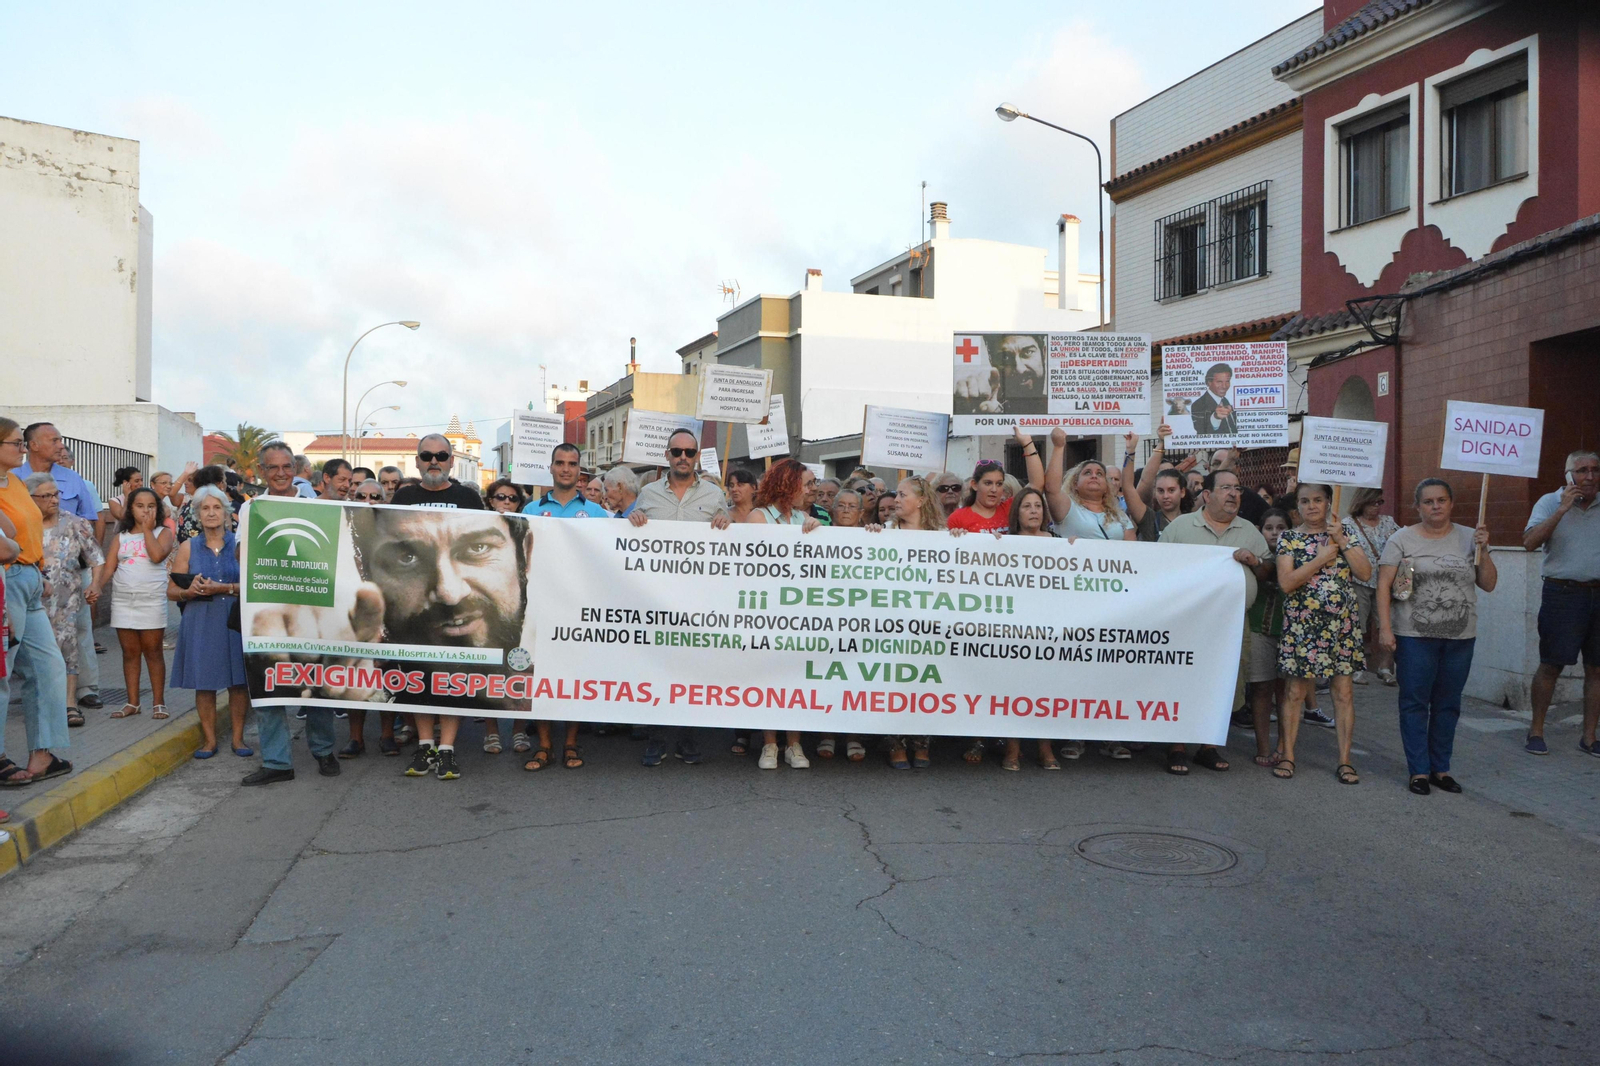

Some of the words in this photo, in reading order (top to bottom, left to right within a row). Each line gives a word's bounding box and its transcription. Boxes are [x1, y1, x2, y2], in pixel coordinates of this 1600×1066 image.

[1060, 359, 1128, 369] ¡¡¡DESPERTAD!!!
[1380, 376, 1386, 392] 6
[1075, 401, 1090, 410] LA
[1093, 401, 1120, 411] VIDA
[1240, 396, 1275, 406] ¡¡¡YA!!!
[975, 418, 994, 426] POR
[997, 418, 1017, 426] UNA
[1019, 418, 1060, 426] SANIDAD
[1062, 416, 1101, 426] PÚBLICA
[1103, 418, 1134, 426] DIGNA.
[1454, 417, 1531, 437] SANIDAD
[1341, 436, 1373, 444] ANDALUCIA
[887, 449, 909, 457] SUSANA
[1461, 439, 1519, 458] DIGNA
[520, 462, 545, 470] HOSPITAL
[1320, 468, 1347, 476] HOSPITAL
[615, 537, 706, 555] NOSOTROS
[709, 541, 741, 556] TAN
[745, 540, 789, 558] SÓLO
[793, 541, 863, 560] ÉRAMOS
[867, 547, 903, 564] 300,
[907, 549, 950, 563] PERO
[954, 548, 1019, 567] ÍBAMOS
[1022, 555, 1078, 571] TODOS
[1082, 558, 1094, 572] A
[1097, 559, 1138, 575] UNA.
[255, 557, 278, 567] JUNTA
[280, 559, 289, 568] DE
[291, 560, 329, 571] ANDALUCIA
[253, 572, 277, 581] Servicio
[278, 574, 302, 583] Andaluz
[311, 576, 329, 585] Salud
[624, 557, 645, 572] LA
[649, 557, 704, 575] UNIÓN
[708, 561, 730, 576] DE
[734, 562, 795, 580] TODOS,
[800, 564, 827, 579] SIN
[830, 564, 933, 585] EXCEPCIÓN,
[936, 569, 955, 583] ES
[959, 570, 980, 585] LA
[983, 572, 1035, 588] CLAVE
[1039, 575, 1070, 590] DEL
[1073, 574, 1129, 593] ÉXITO.
[252, 582, 295, 592] CONSEJERIA
[295, 584, 305, 592] DE
[305, 585, 329, 594] SALUD
[738, 590, 768, 610] ¡¡¡
[779, 586, 1014, 614] DESPERTAD!!!
[580, 607, 601, 622] EN
[605, 608, 642, 624] ESTA
[645, 610, 730, 628] SITUACIÓN
[733, 614, 834, 631] PROVOCADA
[838, 617, 870, 632] POR
[874, 619, 904, 633] LOS
[908, 619, 941, 636] QUE
[945, 621, 1059, 643] ¿GOBIERNAN?,
[1062, 626, 1095, 643] NOS
[1099, 628, 1170, 645] ESTAMOS
[551, 626, 630, 644] JUGANDO
[633, 630, 651, 645] EL
[654, 631, 747, 651] BIENESTAR,
[751, 635, 771, 650] LA
[774, 635, 834, 654] SALUD,
[838, 638, 858, 653] LA
[862, 639, 946, 656] DIGNIDAD
[950, 641, 959, 656] E
[963, 642, 1031, 660] INCLUSO
[1035, 645, 1055, 661] LO
[1058, 644, 1093, 662] MÁS
[1097, 648, 1194, 666] IMPORTANTE
[805, 660, 848, 681] LA
[857, 661, 942, 684] VIDA
[265, 662, 425, 693] ¡EXIGIMOS
[431, 672, 660, 706] ESPECIALISTAS,
[669, 683, 833, 714] PERSONAL,
[841, 690, 957, 715] MEDIOS
[963, 693, 983, 715] Y
[989, 695, 1129, 720] HOSPITAL
[1136, 700, 1179, 722] YA!
